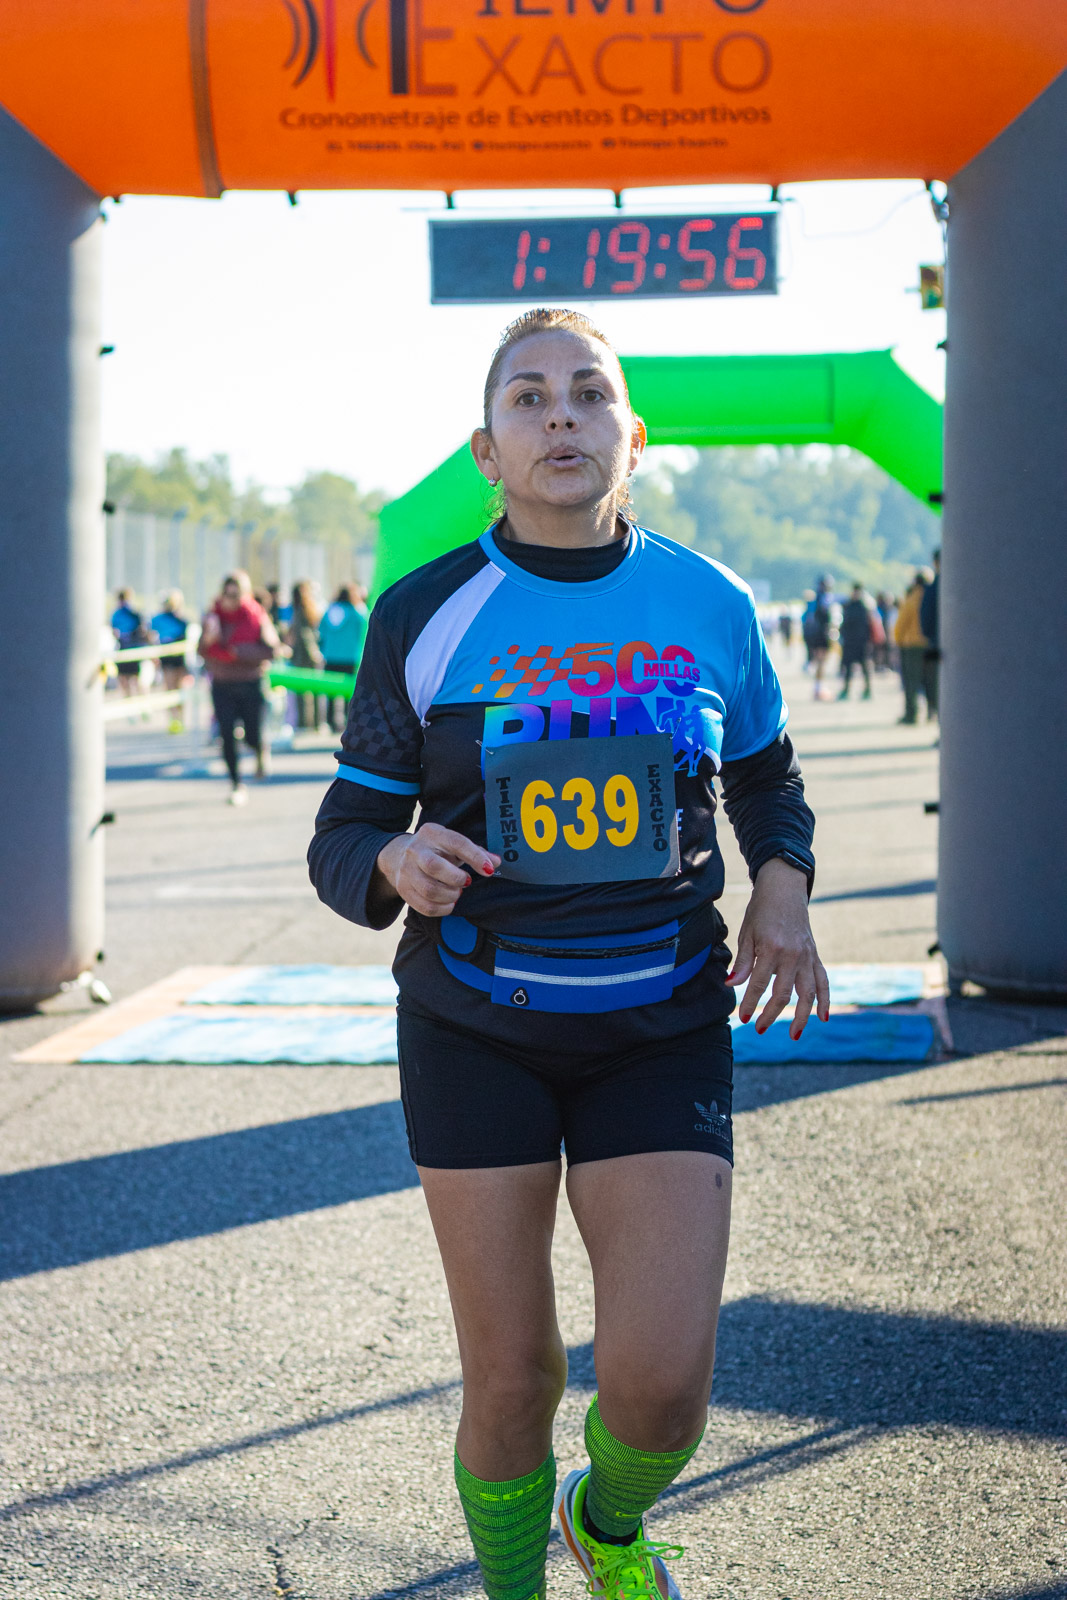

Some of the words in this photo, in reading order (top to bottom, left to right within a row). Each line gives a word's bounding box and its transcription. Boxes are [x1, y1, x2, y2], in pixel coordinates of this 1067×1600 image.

[279, 107, 461, 132] Cronometraje
[467, 105, 500, 128] de
[508, 104, 614, 127] Eventos
[620, 102, 772, 128] Deportivos
[513, 217, 767, 294] 1:19:56
[643, 662, 701, 683] MILLAS
[495, 776, 520, 863] TIEMPO
[520, 774, 640, 853] 639
[646, 764, 668, 852] EXACTO
